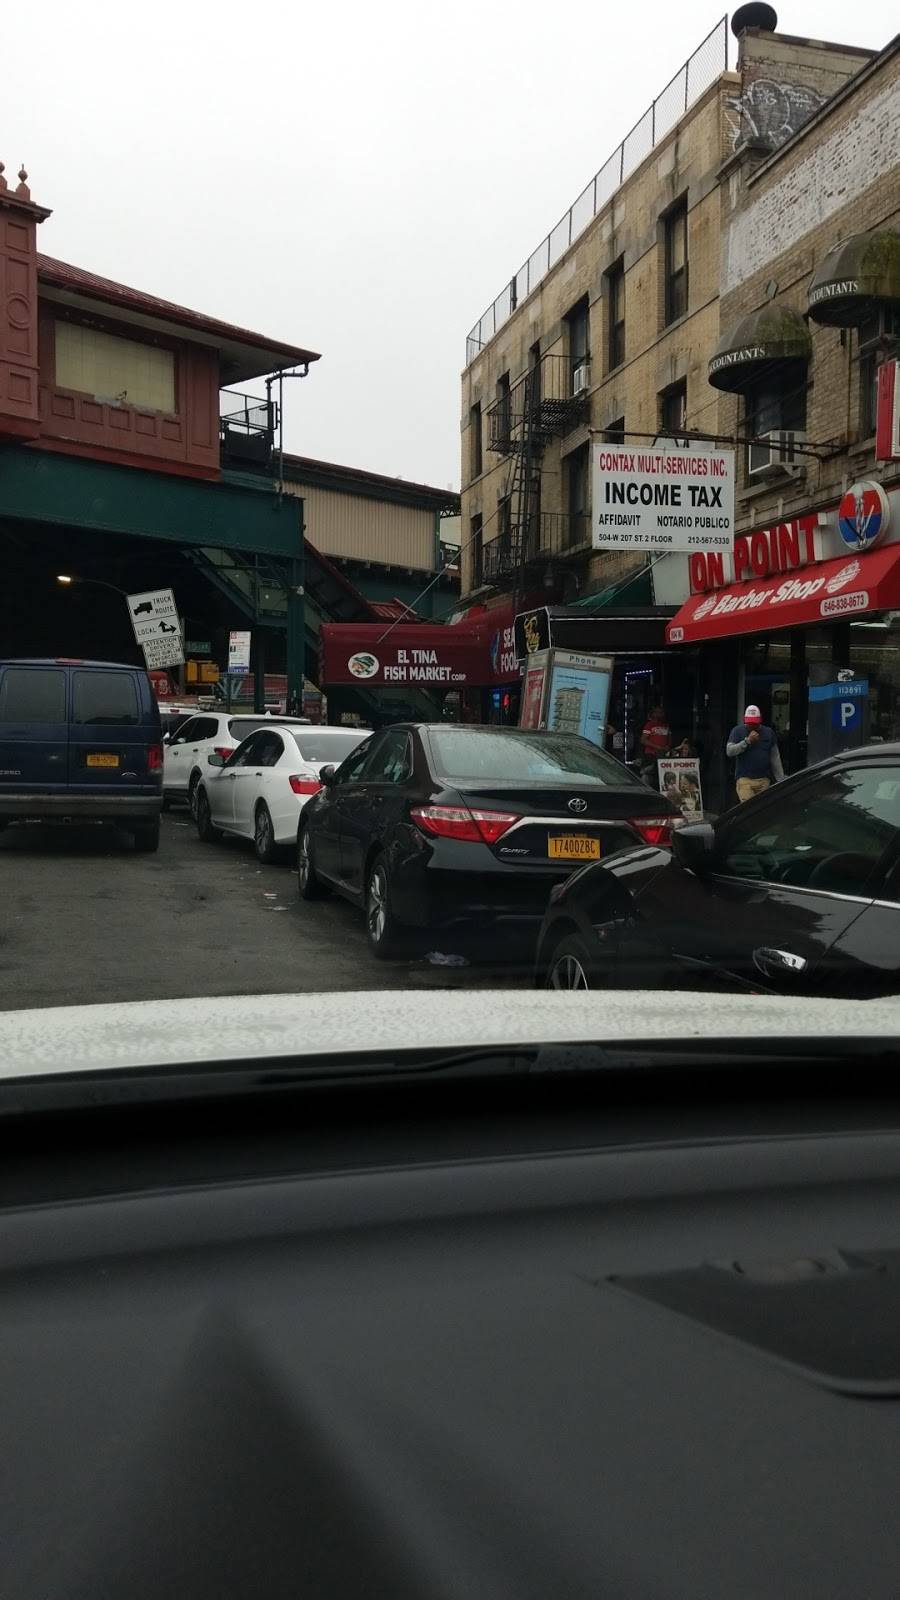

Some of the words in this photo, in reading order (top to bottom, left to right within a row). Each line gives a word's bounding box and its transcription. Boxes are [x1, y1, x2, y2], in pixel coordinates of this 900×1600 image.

[600, 453, 635, 472] CONTAX
[638, 455, 708, 476] MULTI-SERVICES
[710, 459, 728, 476] INC.
[605, 482, 681, 506] INCOME
[688, 485, 722, 507] TAX
[598, 514, 641, 526] AFFIDAVIT
[657, 516, 692, 527] NOTARIO
[694, 516, 730, 528] PUBLICO
[689, 552, 725, 594] ON
[734, 513, 821, 580] POINT
[153, 596, 172, 605] TRUCK
[711, 592, 775, 616] Barber
[770, 576, 826, 605] Shop
[155, 606, 174, 615] ROUTE
[138, 627, 157, 636] LOCAL
[397, 650, 409, 664] EL
[412, 650, 438, 664] TINA
[569, 655, 597, 666] Phone
[383, 666, 407, 681] FISH
[409, 667, 451, 681] MARKET
[841, 703, 856, 727] P
[674, 761, 697, 769] POINT
[552, 839, 597, 854] T740028C
